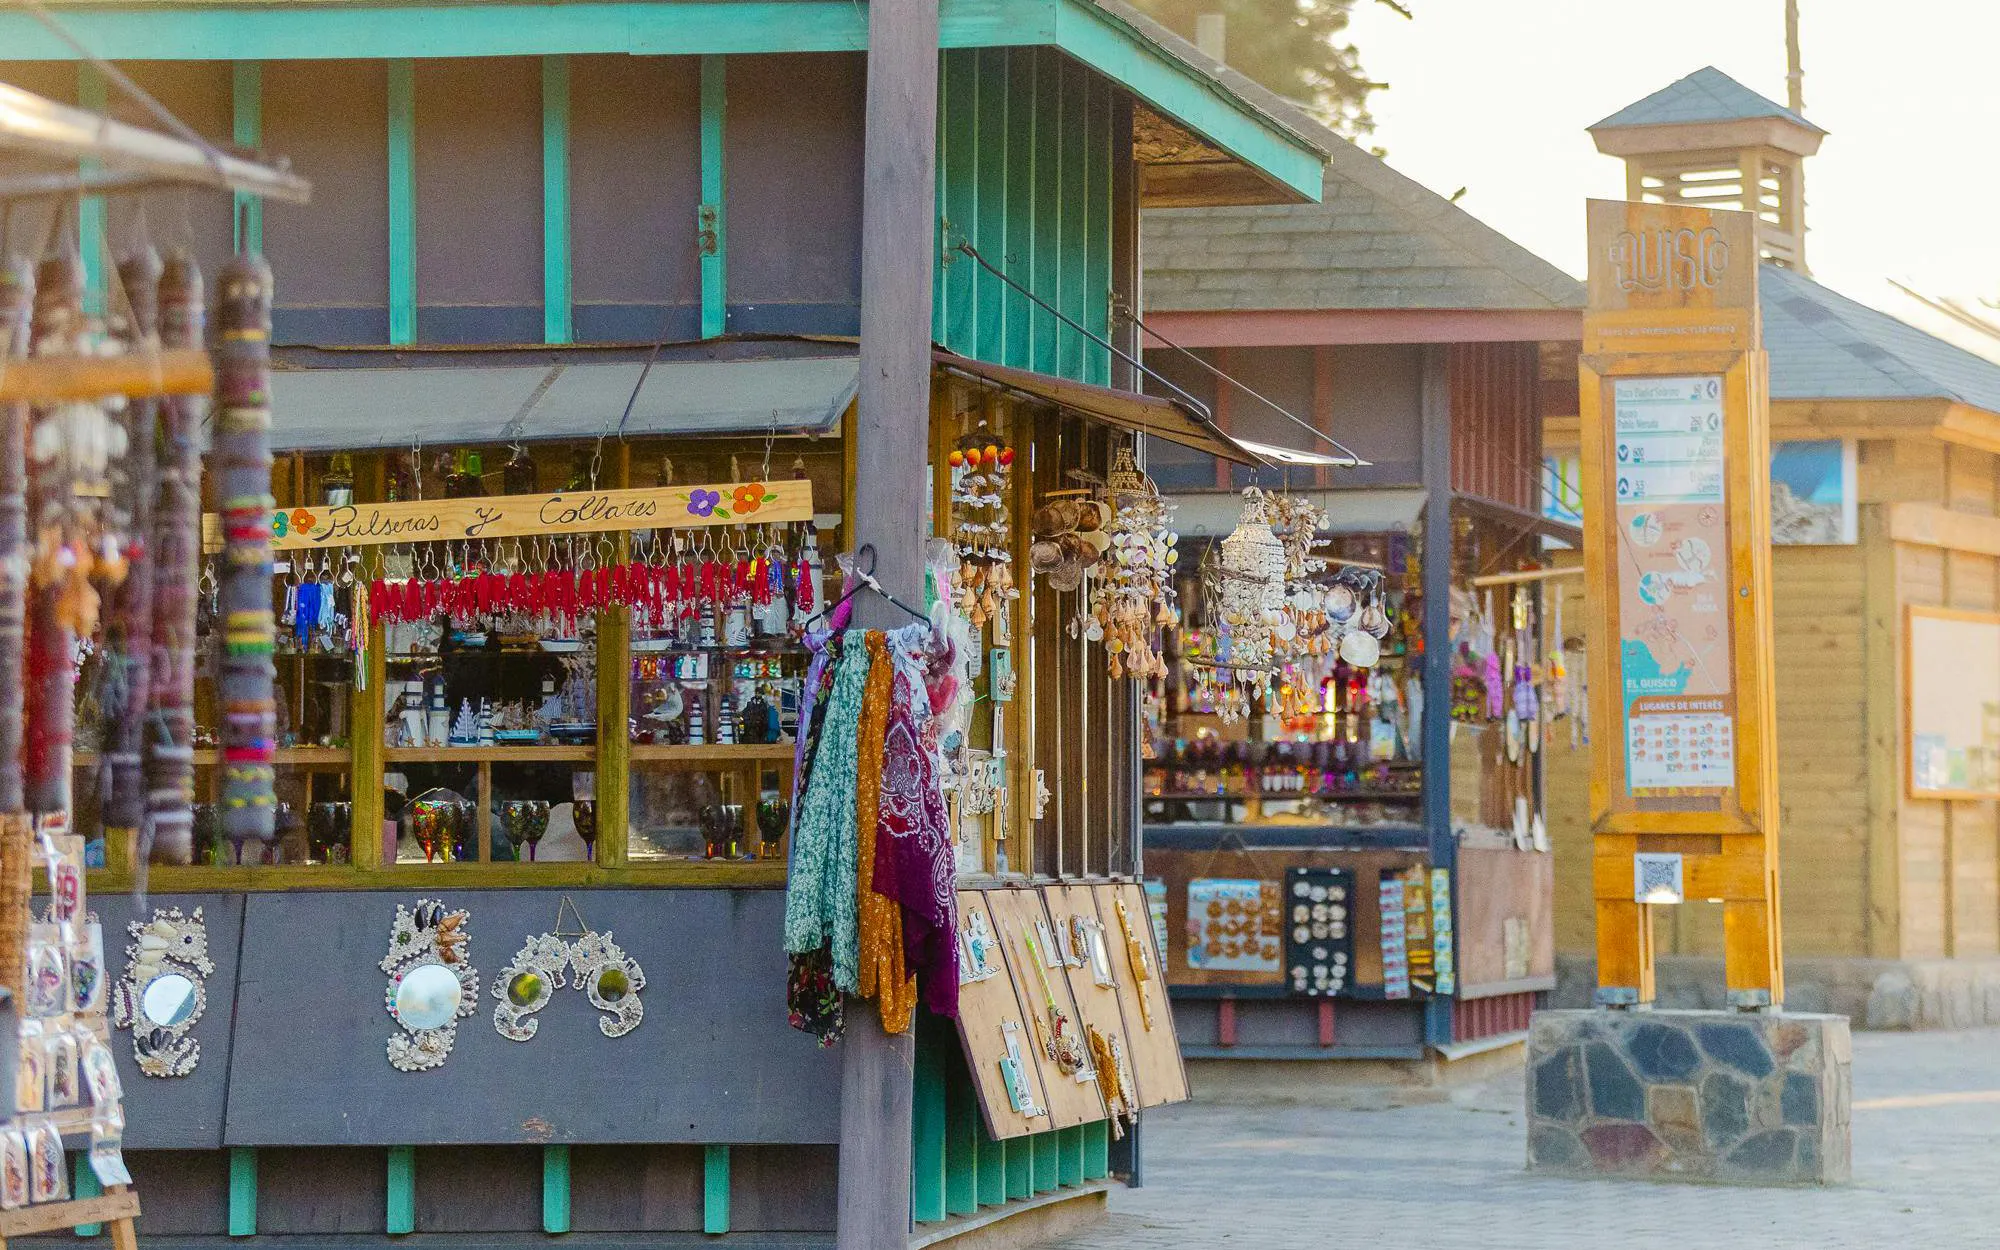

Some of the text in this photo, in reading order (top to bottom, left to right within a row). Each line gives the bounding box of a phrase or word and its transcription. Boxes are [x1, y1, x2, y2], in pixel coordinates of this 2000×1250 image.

[312, 495, 657, 543] Pulseras y Collares
[1626, 678, 1677, 689] EL QUISCO
